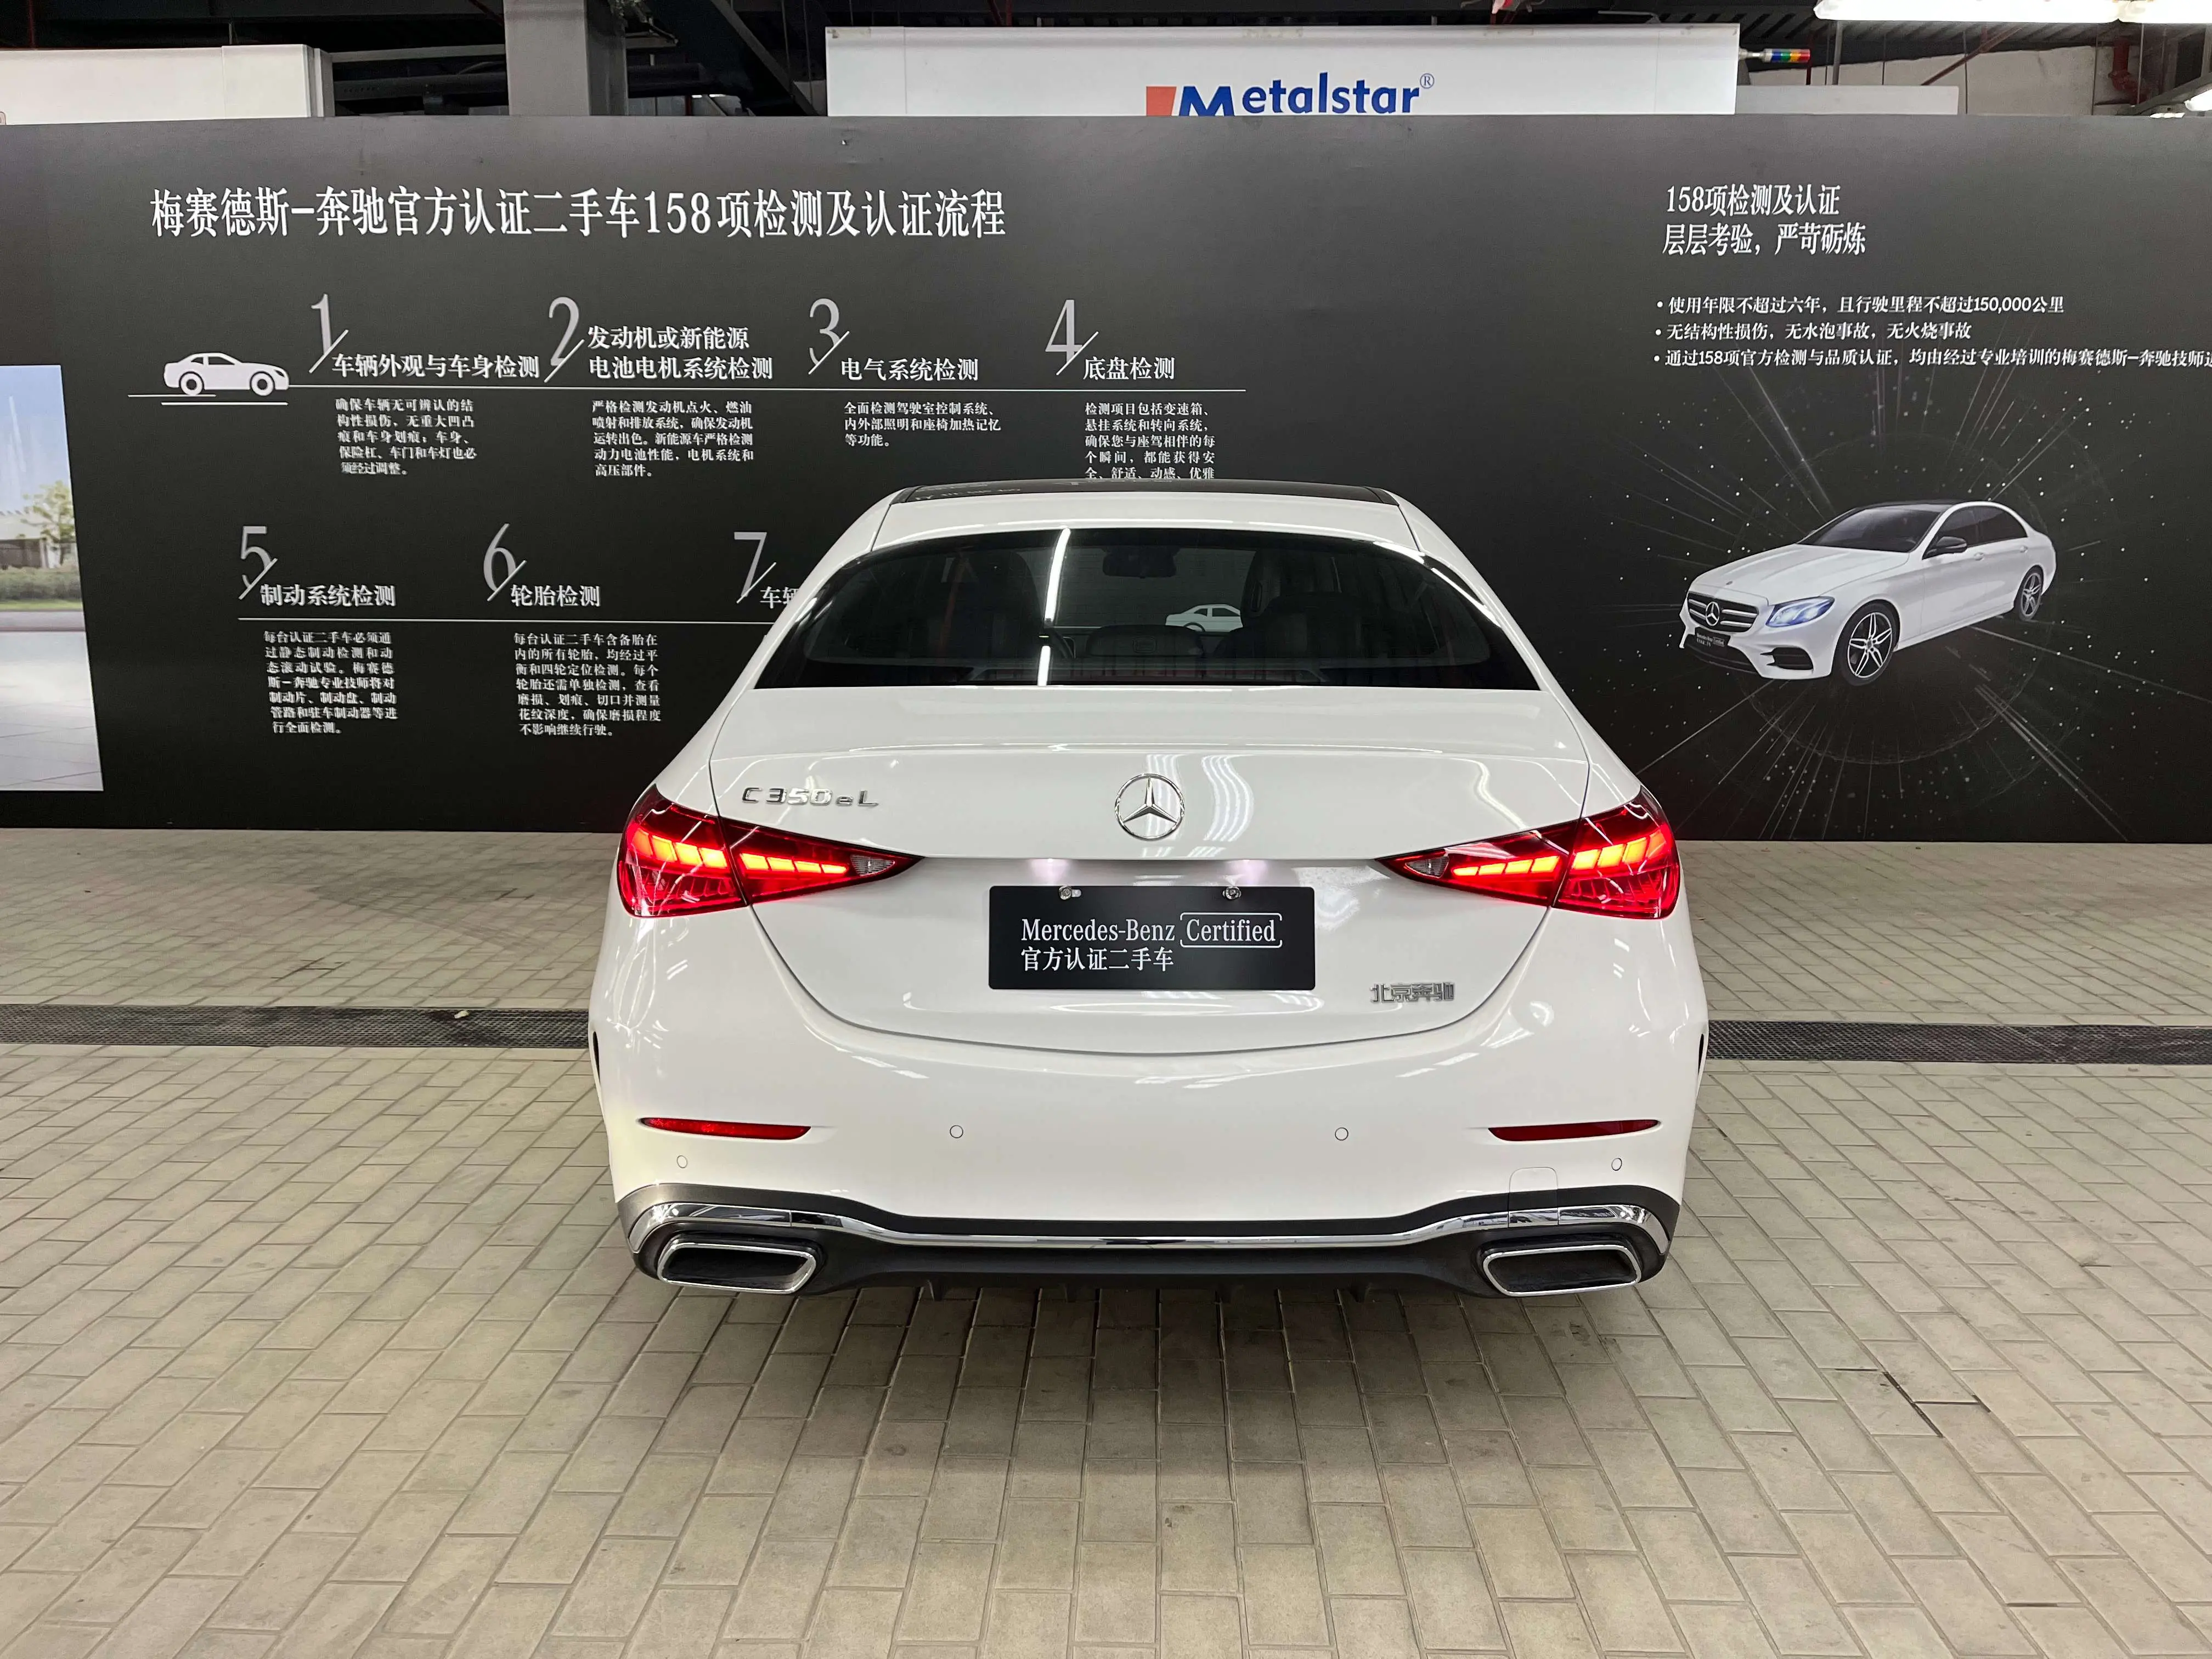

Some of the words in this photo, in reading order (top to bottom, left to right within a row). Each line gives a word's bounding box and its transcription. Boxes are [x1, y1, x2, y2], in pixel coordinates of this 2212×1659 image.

[1667, 183, 1841, 217] 158项检测及认证
[1662, 222, 1866, 256] 层层考验，严苛砺炼
[311, 294, 337, 356] 1
[549, 295, 580, 366] 2
[809, 297, 840, 366] 3
[1045, 299, 1083, 364] 4
[1667, 321, 1972, 340] 无结构性损伤，无水泡事故，无火烧事故
[588, 325, 749, 350] 发动机或新能源
[331, 353, 540, 379] 车辆外观与车身检测
[589, 356, 772, 380] 电池电机系统检测
[841, 357, 978, 381] 电气系统检测
[1083, 357, 1176, 380] 底盘检测
[592, 400, 752, 414] 严格检测发动机点火、燃油
[844, 401, 993, 415] 全面检测驾驶室控制系统、
[1085, 402, 1208, 416] 检测项目包括变速箱、
[592, 416, 753, 430] 喷射和排放系统，确保发动机
[845, 417, 1001, 431] 内外部照明和座椅加热记忆
[1085, 418, 1207, 432] 悬挂系统和转向系统，
[593, 432, 753, 445] 运转出色。新能源车严格检测
[845, 433, 889, 447] 等功能。
[1085, 434, 1215, 448] 确保您与座驾相伴的每
[594, 448, 754, 461] 动力电池性能，电机系统和
[1085, 450, 1215, 464] 个瞬间，都能获得安
[595, 463, 652, 477] 高压部件。
[240, 526, 272, 590] 5
[483, 523, 517, 594] 6
[733, 532, 768, 597] 7
[260, 584, 396, 606] 制动系统检测
[510, 584, 601, 607] 轮胎检测
[514, 633, 658, 646] 每台认证二手车含备胎在
[515, 647, 658, 662] 内的所有轮胎，均经过平
[516, 663, 659, 676] 衡和四轮定位检测。每个
[516, 678, 659, 692] 轮胎还需单独检测，查看
[517, 693, 660, 707] 磨损、划痕、切口并测量
[519, 708, 661, 721] 花纹深度，确保磨损程度
[520, 723, 612, 736] 不影响继续行驶。
[1021, 918, 1175, 941] Mercedes-Benz
[1186, 918, 1276, 943] Certified
[1020, 946, 1175, 972] 官方认证二手车
[1370, 983, 1455, 1003] 北京奔驰
